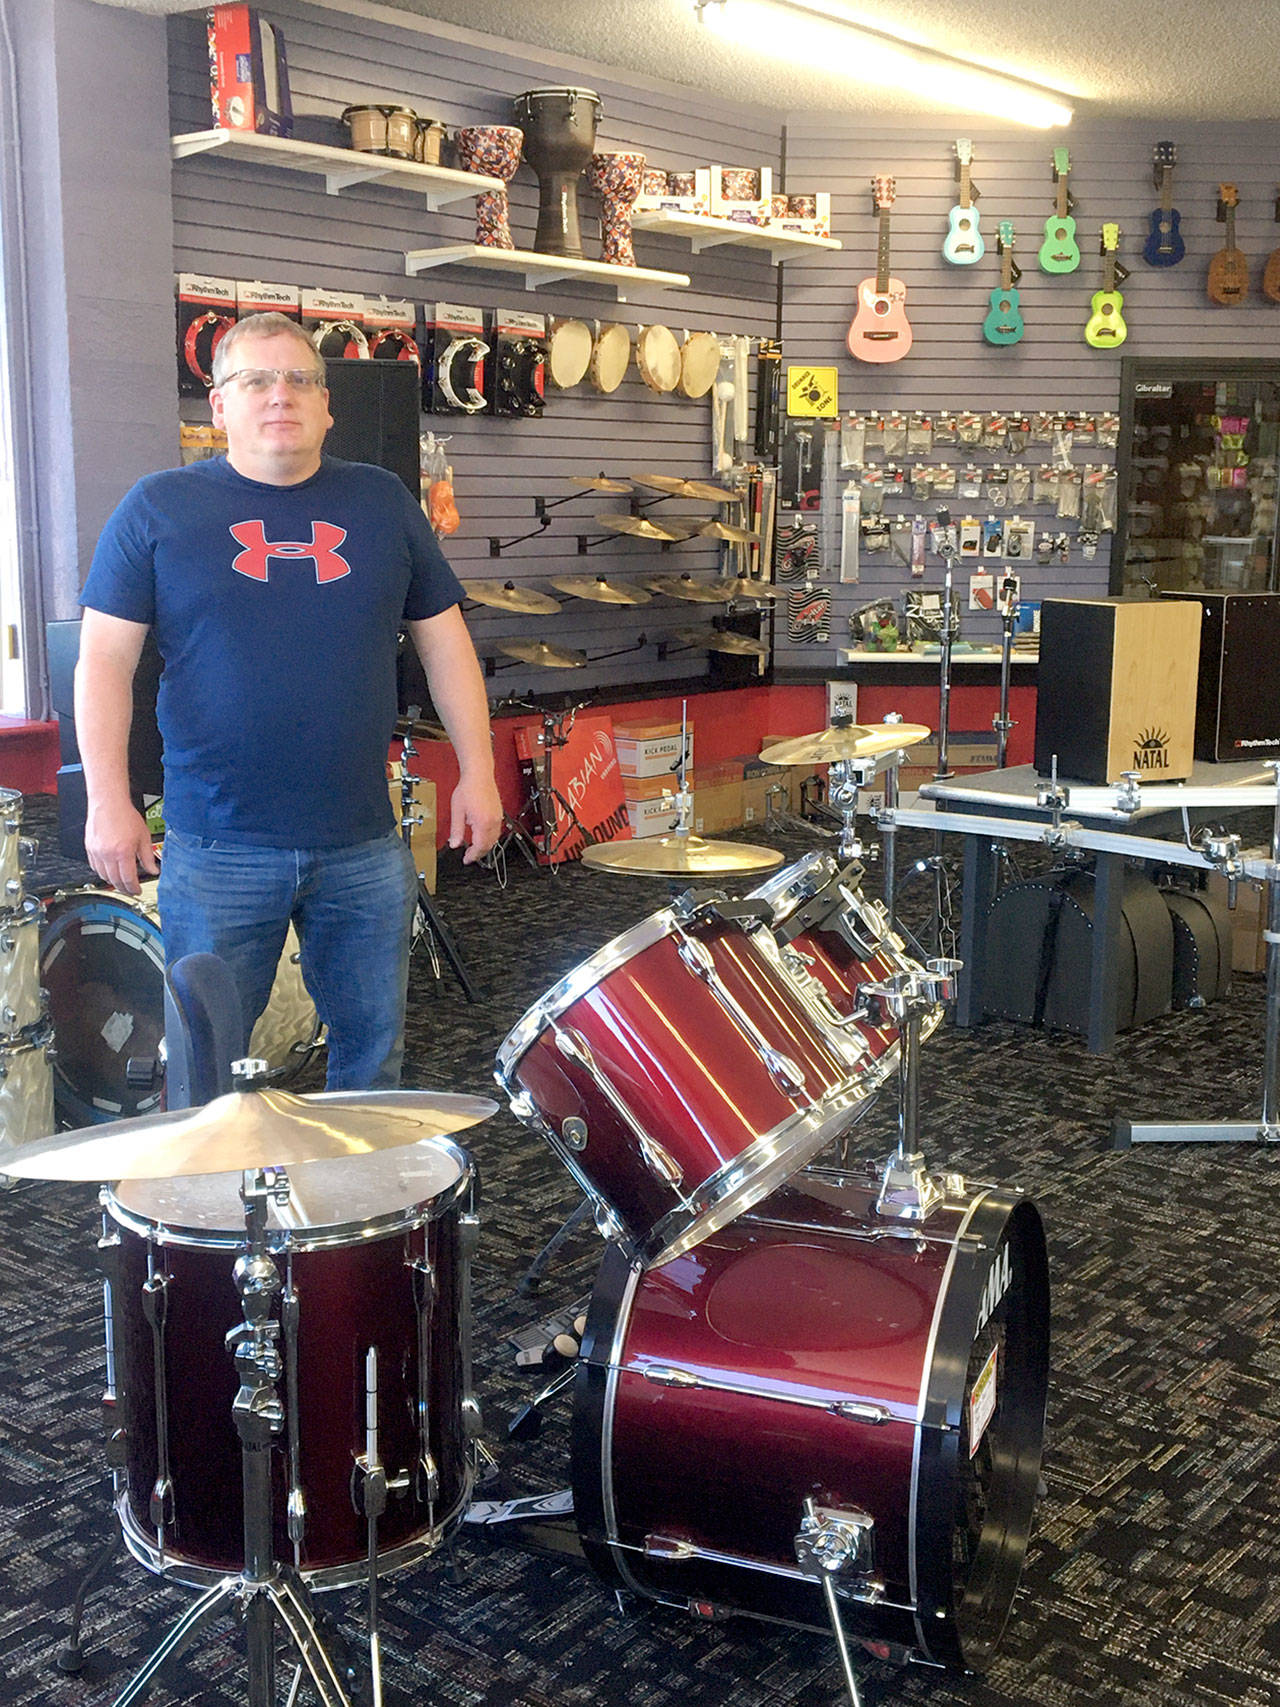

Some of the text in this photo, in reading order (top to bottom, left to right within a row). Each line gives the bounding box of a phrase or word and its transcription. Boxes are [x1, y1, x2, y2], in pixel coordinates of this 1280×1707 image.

[1135, 383, 1171, 392] Gibraltar
[1132, 749, 1170, 770] NATAL
[973, 1241, 1014, 1342] AMA
